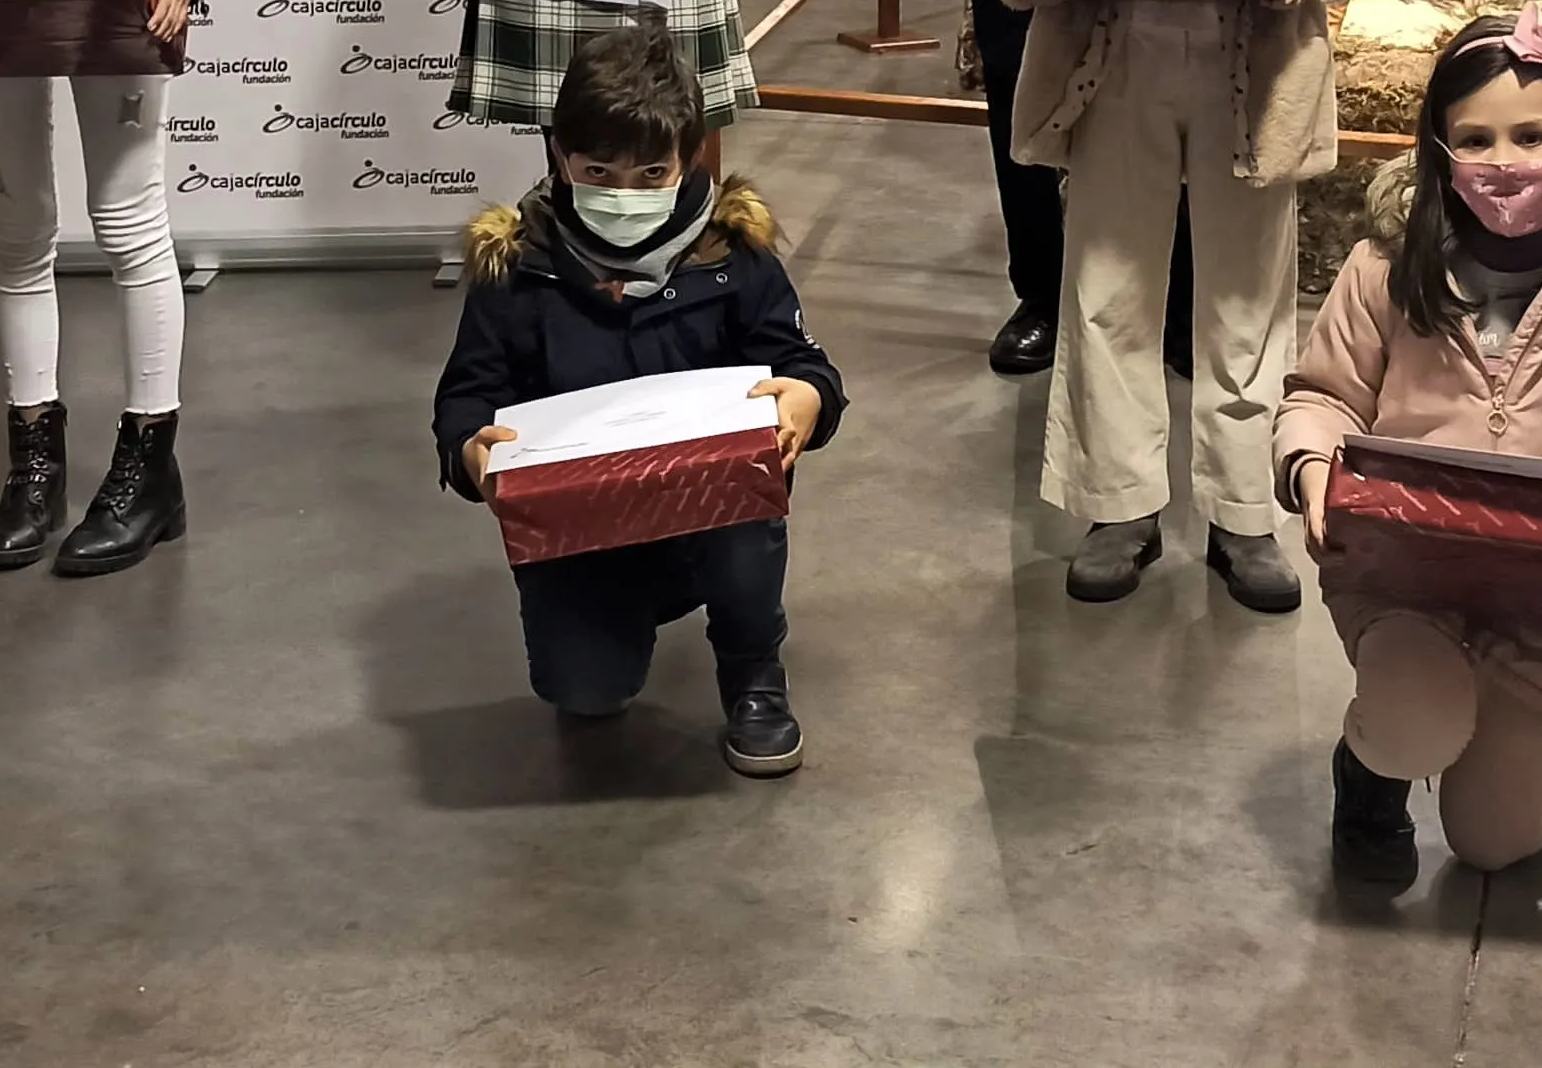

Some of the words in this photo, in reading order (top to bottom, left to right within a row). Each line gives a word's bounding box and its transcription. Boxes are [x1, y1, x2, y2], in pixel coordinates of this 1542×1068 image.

[336, 13, 385, 24] fundación
[196, 57, 288, 77] cajacírculo
[242, 74, 292, 85] fundación
[418, 71, 455, 81] fundaci
[168, 116, 215, 132] írculo
[295, 111, 387, 133] cajacírculo
[170, 133, 219, 143] fundación
[340, 129, 390, 140] fundación
[210, 171, 301, 192] cajacírculo
[385, 168, 476, 189] cajacírculo
[255, 188, 305, 199] fundación
[430, 184, 479, 195] fundación
